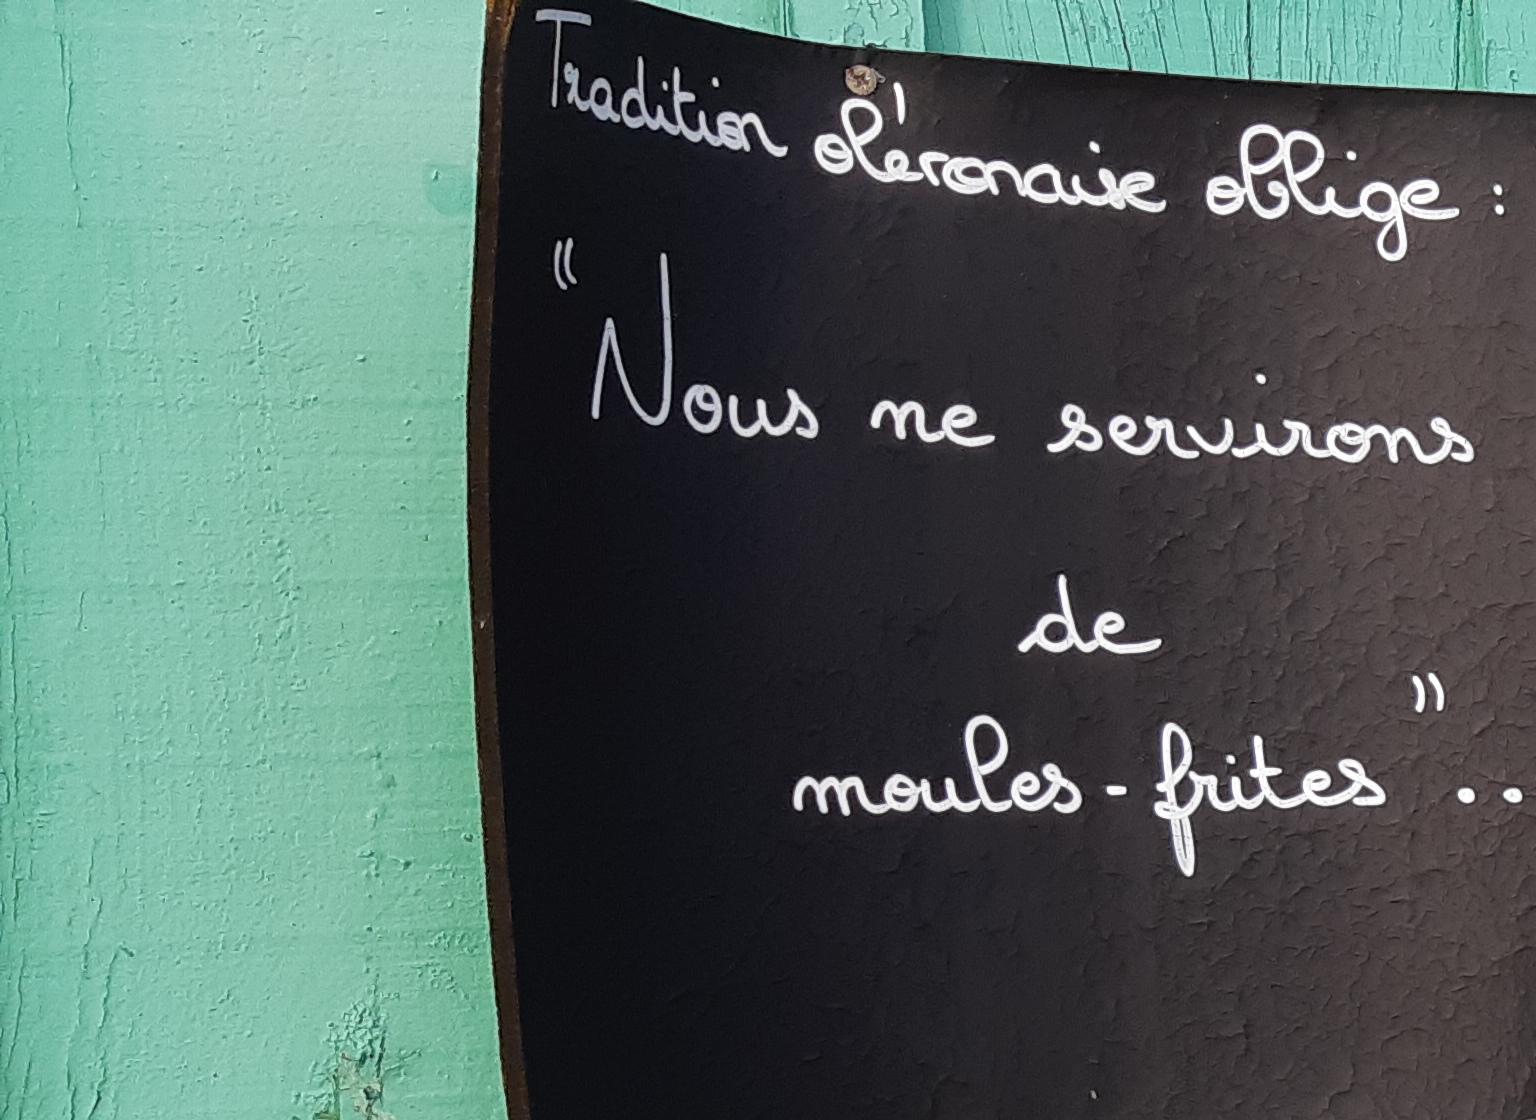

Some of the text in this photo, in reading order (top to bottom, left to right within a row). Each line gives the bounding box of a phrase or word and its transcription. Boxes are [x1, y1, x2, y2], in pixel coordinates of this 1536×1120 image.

[536, 9, 789, 158] Tradition
[1206, 124, 1459, 261] oblige
[871, 401, 995, 447] ne
[1047, 374, 1474, 464] servirons
[1018, 574, 1162, 655] de
